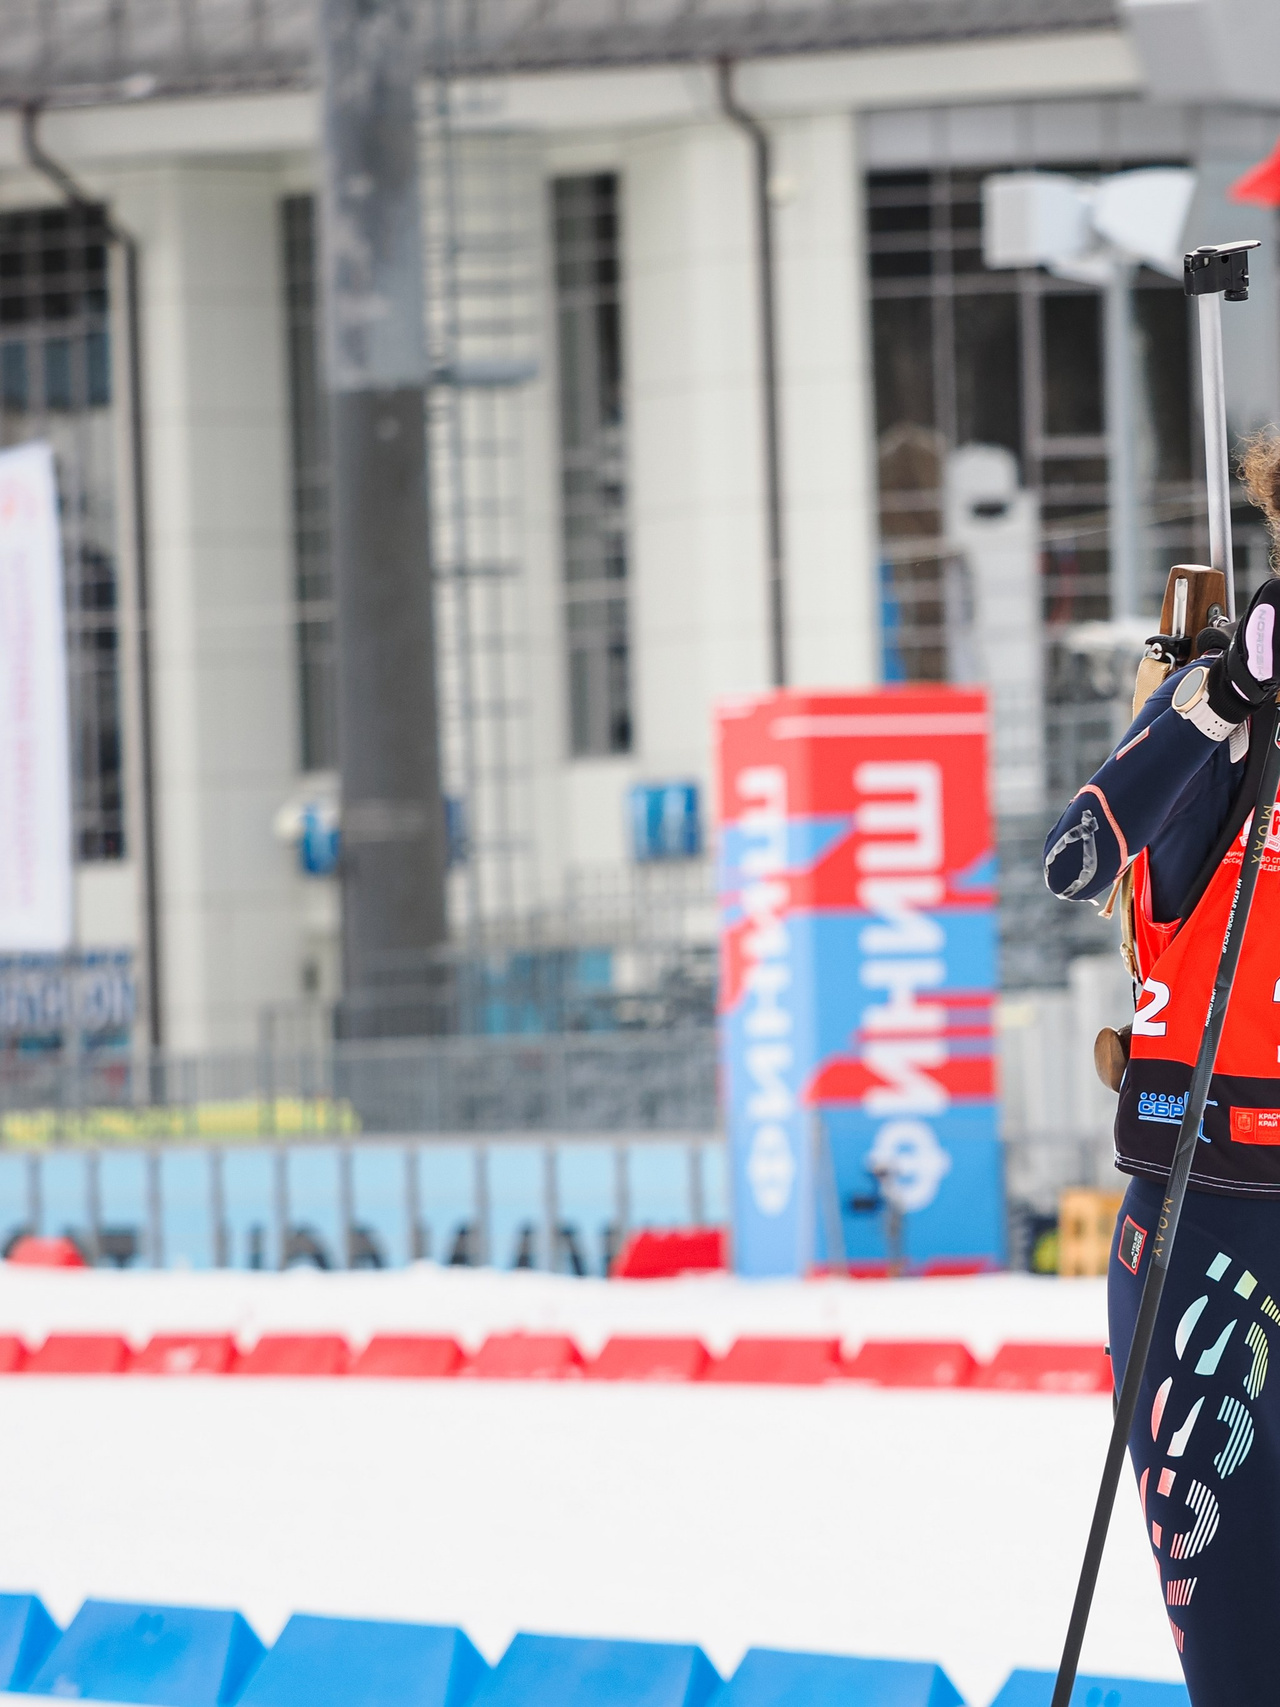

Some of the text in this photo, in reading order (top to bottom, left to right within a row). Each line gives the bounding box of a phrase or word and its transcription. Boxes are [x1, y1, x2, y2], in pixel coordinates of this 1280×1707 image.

[1251, 805, 1273, 863] MOAX
[1222, 910, 1236, 954] WORLDCUP
[736, 764, 796, 1217] ФИНИШ
[852, 759, 951, 1214] ФИНИШ
[1131, 976, 1171, 1037] 2
[1138, 1100, 1185, 1118] СБР
[1152, 1197, 1174, 1258] MOAX
